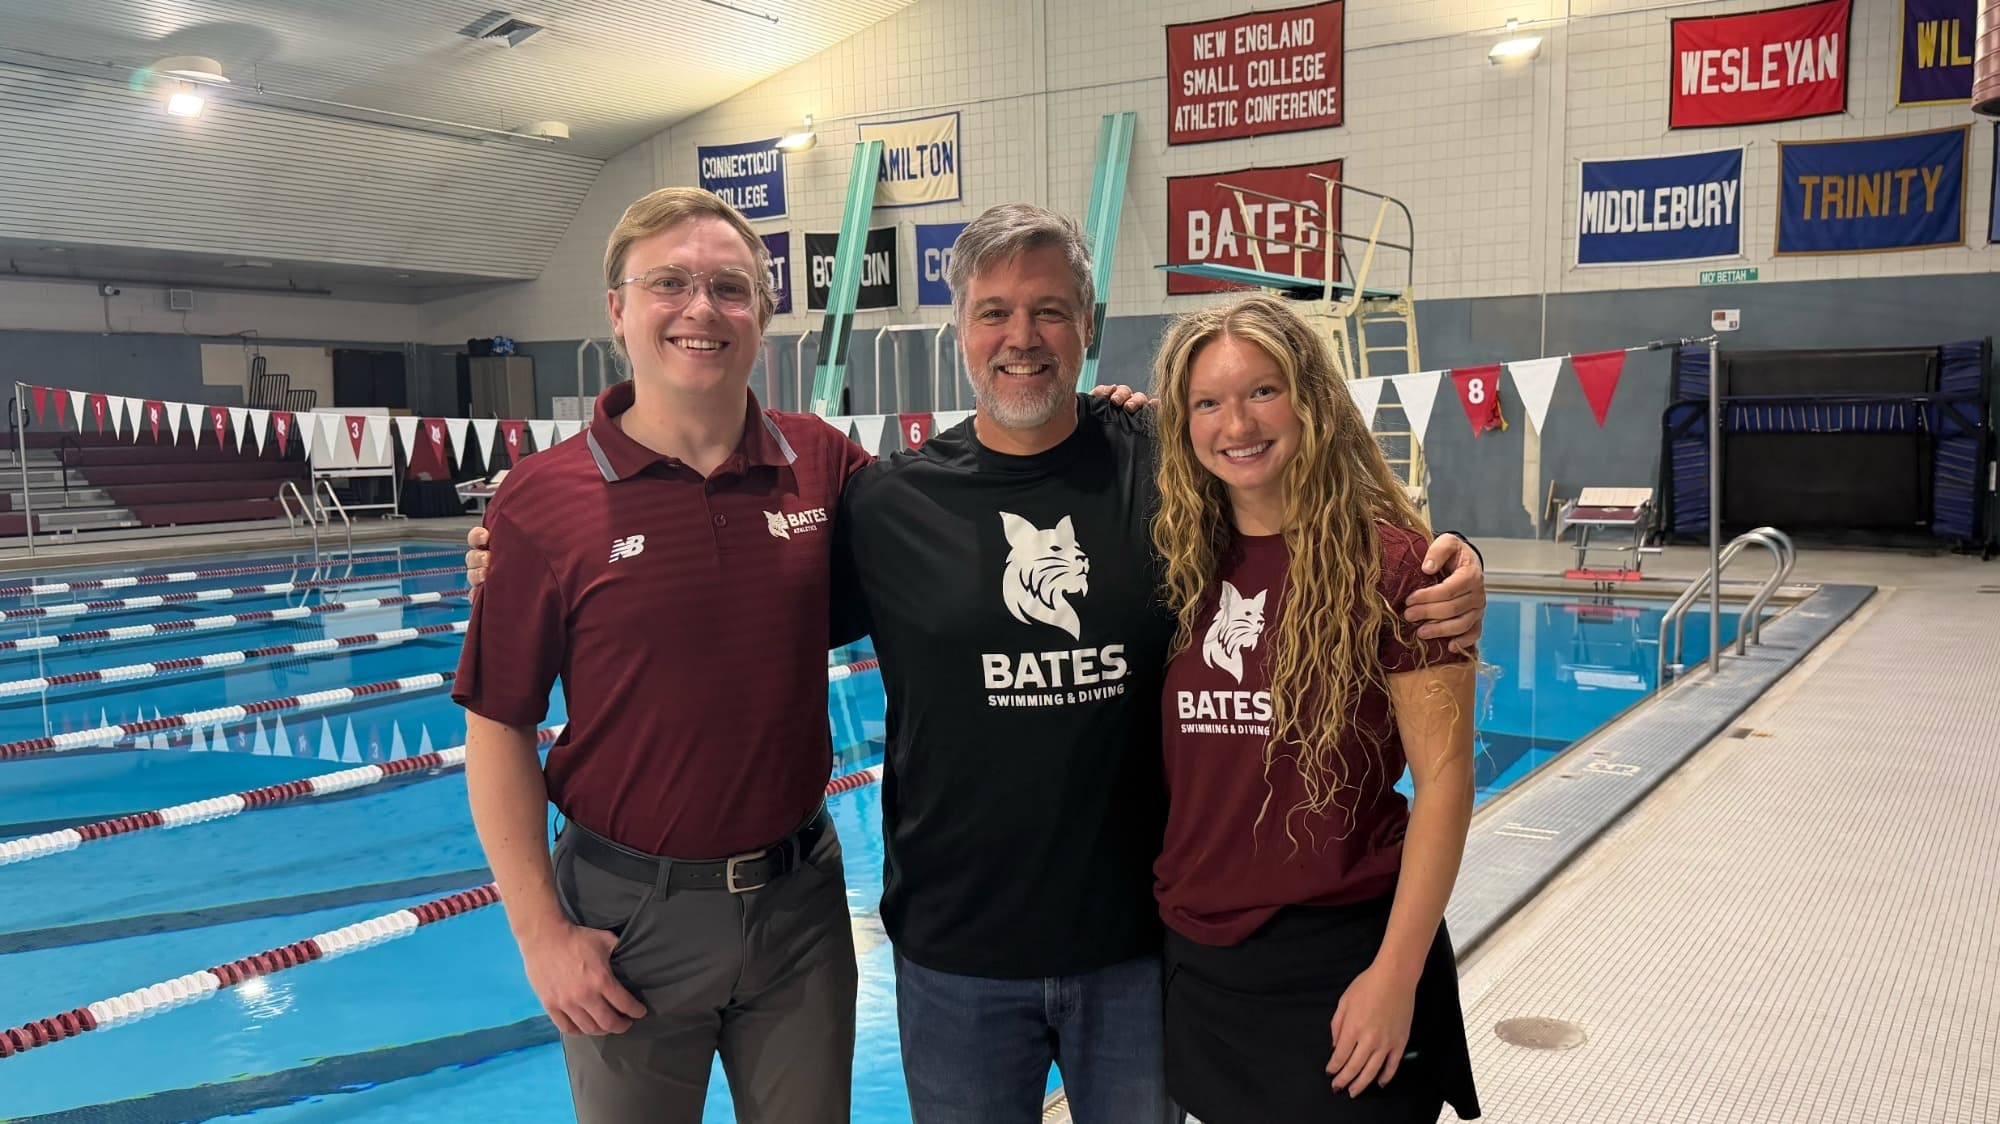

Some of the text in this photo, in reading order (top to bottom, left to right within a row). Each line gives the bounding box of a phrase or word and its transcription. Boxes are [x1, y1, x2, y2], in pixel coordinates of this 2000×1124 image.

[1193, 18, 1314, 61] NEW ENGLAND
[1917, 19, 1972, 69] WIL
[1183, 52, 1326, 96] SMALL COLLEGE
[1681, 33, 1838, 96] WESLEYAN
[1174, 87, 1336, 132] ATHLETIC CONFERENCE
[702, 149, 779, 179] CONNECTICUT
[879, 140, 954, 182] AMILTON
[1581, 179, 1738, 235] MIDDLEBURY
[1798, 165, 1943, 220] TRINITY
[1188, 200, 1319, 260] BATES
[1717, 270, 1746, 282] BETTAH
[1467, 377, 1485, 404] 8
[95, 402, 101, 416] 1
[215, 413, 223, 429] 2
[351, 422, 360, 439] 3
[508, 428, 517, 446] 4
[910, 422, 921, 443] 6
[787, 508, 828, 527] BATES
[981, 644, 1128, 689] BATES
[988, 683, 1125, 707] SWIMMING & DIVING
[1177, 691, 1273, 721] BATES
[1181, 724, 1270, 736] SWIMMING & DIVING
